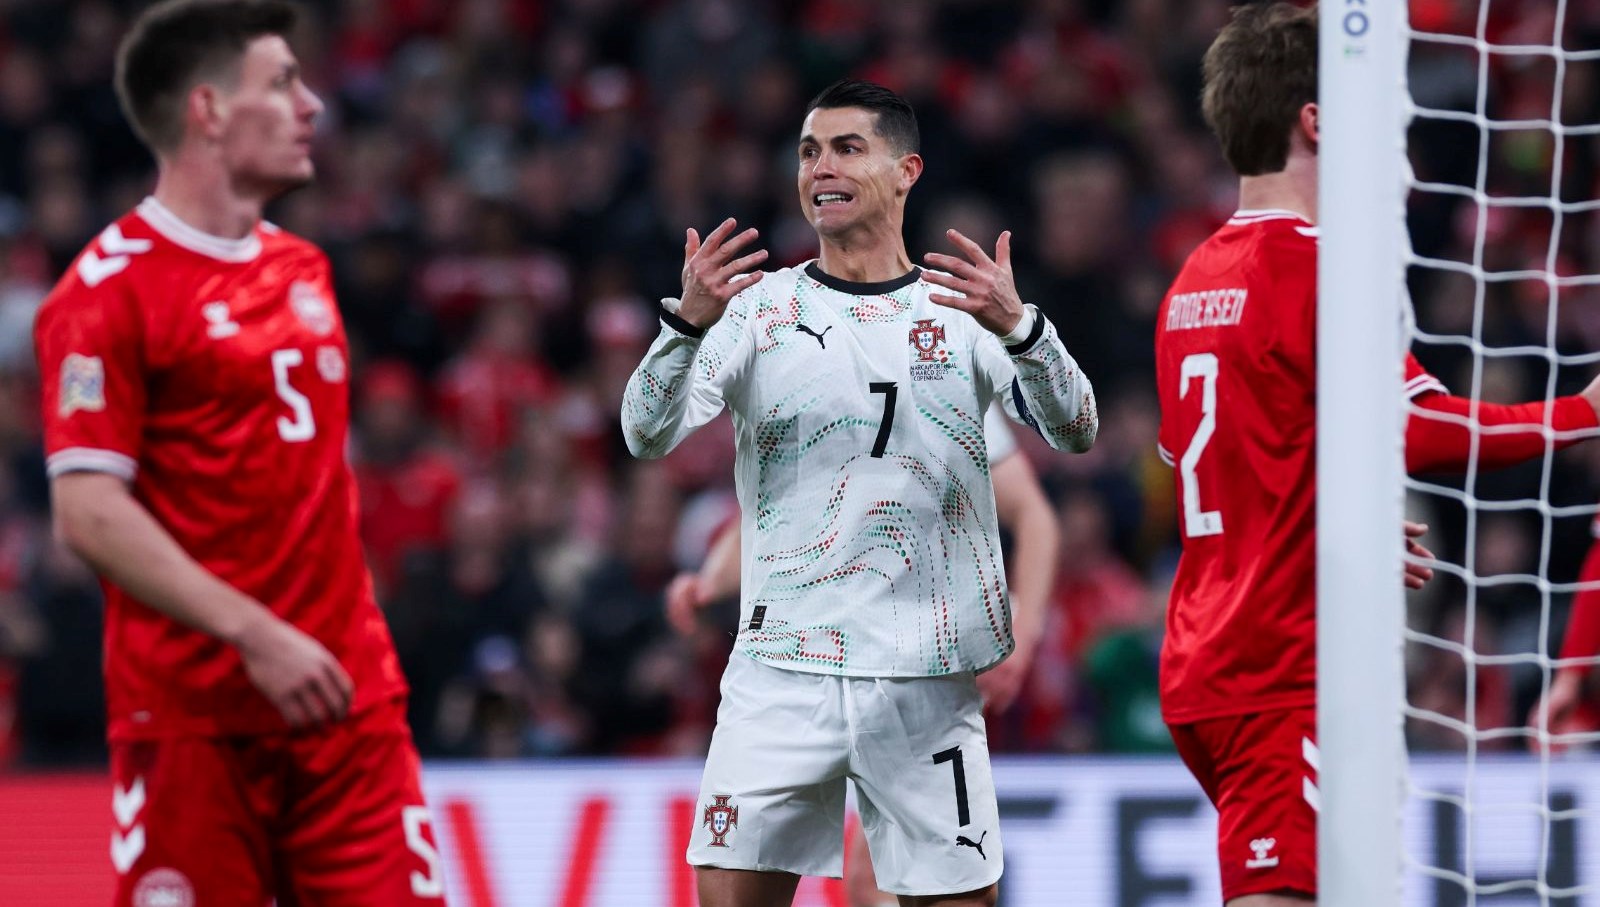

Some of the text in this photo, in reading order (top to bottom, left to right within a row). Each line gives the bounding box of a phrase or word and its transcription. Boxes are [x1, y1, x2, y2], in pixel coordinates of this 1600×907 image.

[1165, 288, 1248, 332] ANDERSEN
[271, 348, 317, 443] 5
[869, 381, 898, 458] 7
[1179, 352, 1225, 538] 2
[932, 745, 970, 828] 7
[402, 804, 444, 897] 5
